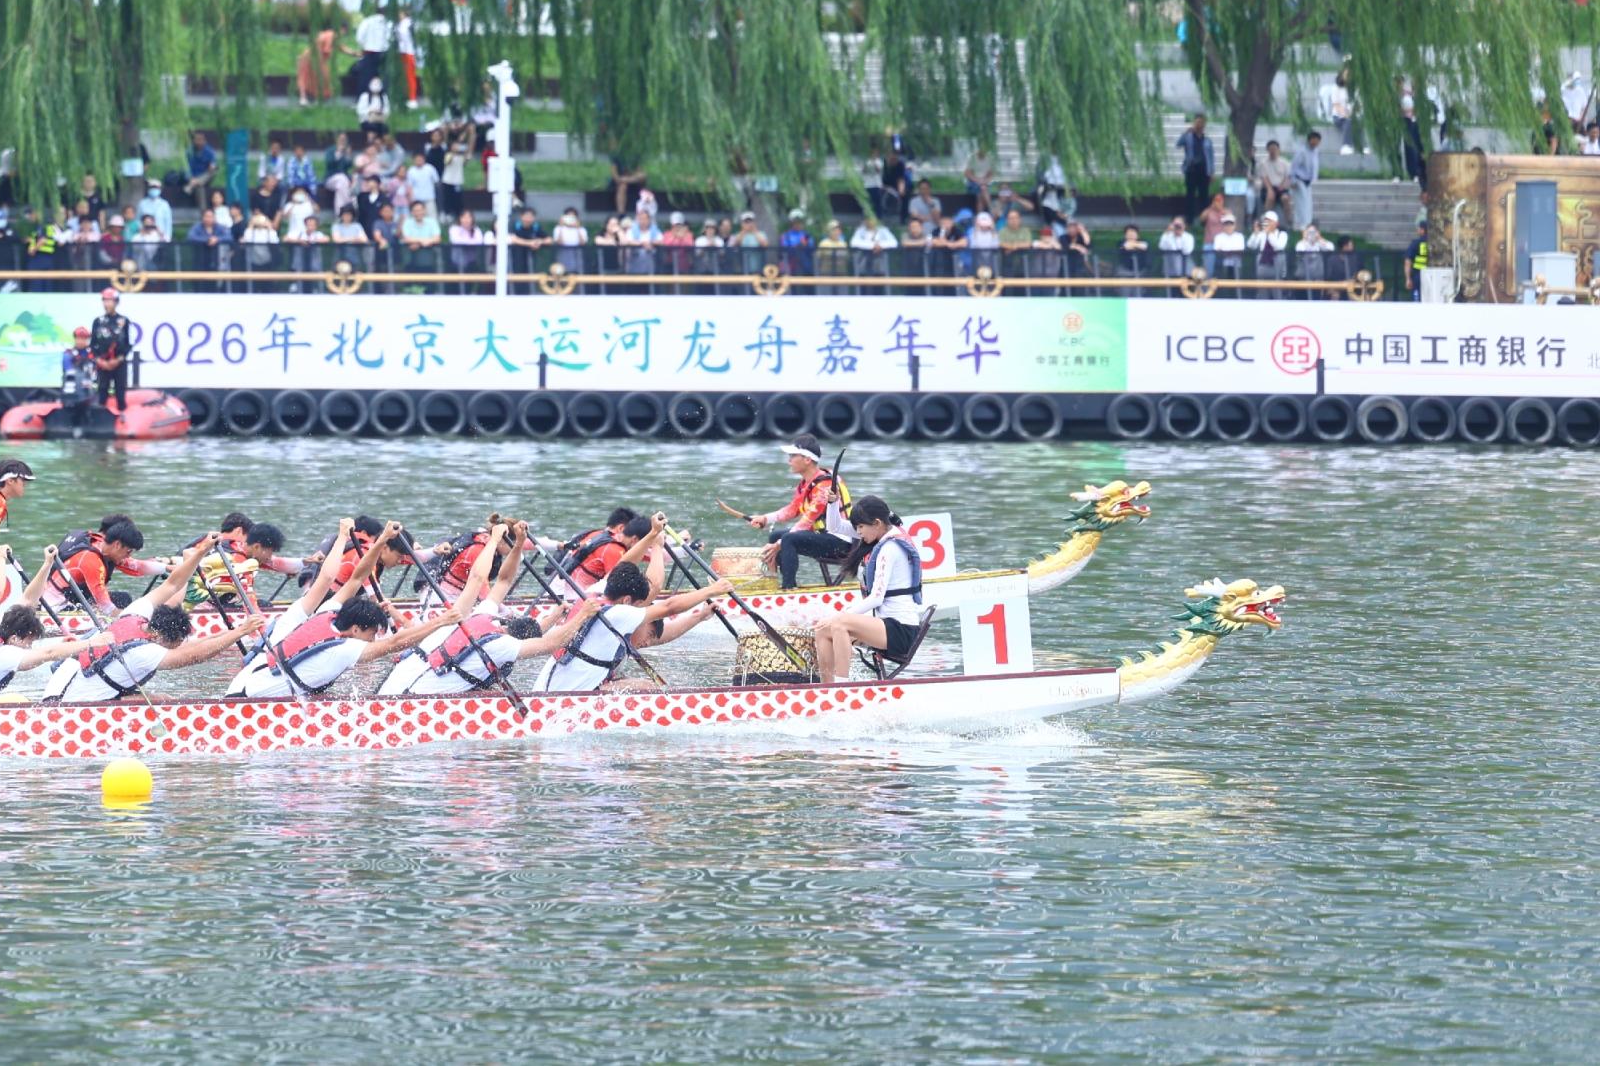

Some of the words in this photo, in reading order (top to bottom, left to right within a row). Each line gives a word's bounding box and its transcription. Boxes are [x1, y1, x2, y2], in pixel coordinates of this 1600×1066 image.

[1166, 335, 1255, 363] ICBC
[1345, 332, 1566, 368] 中国工商银行
[908, 519, 946, 570] 3
[977, 603, 1009, 665] 1
